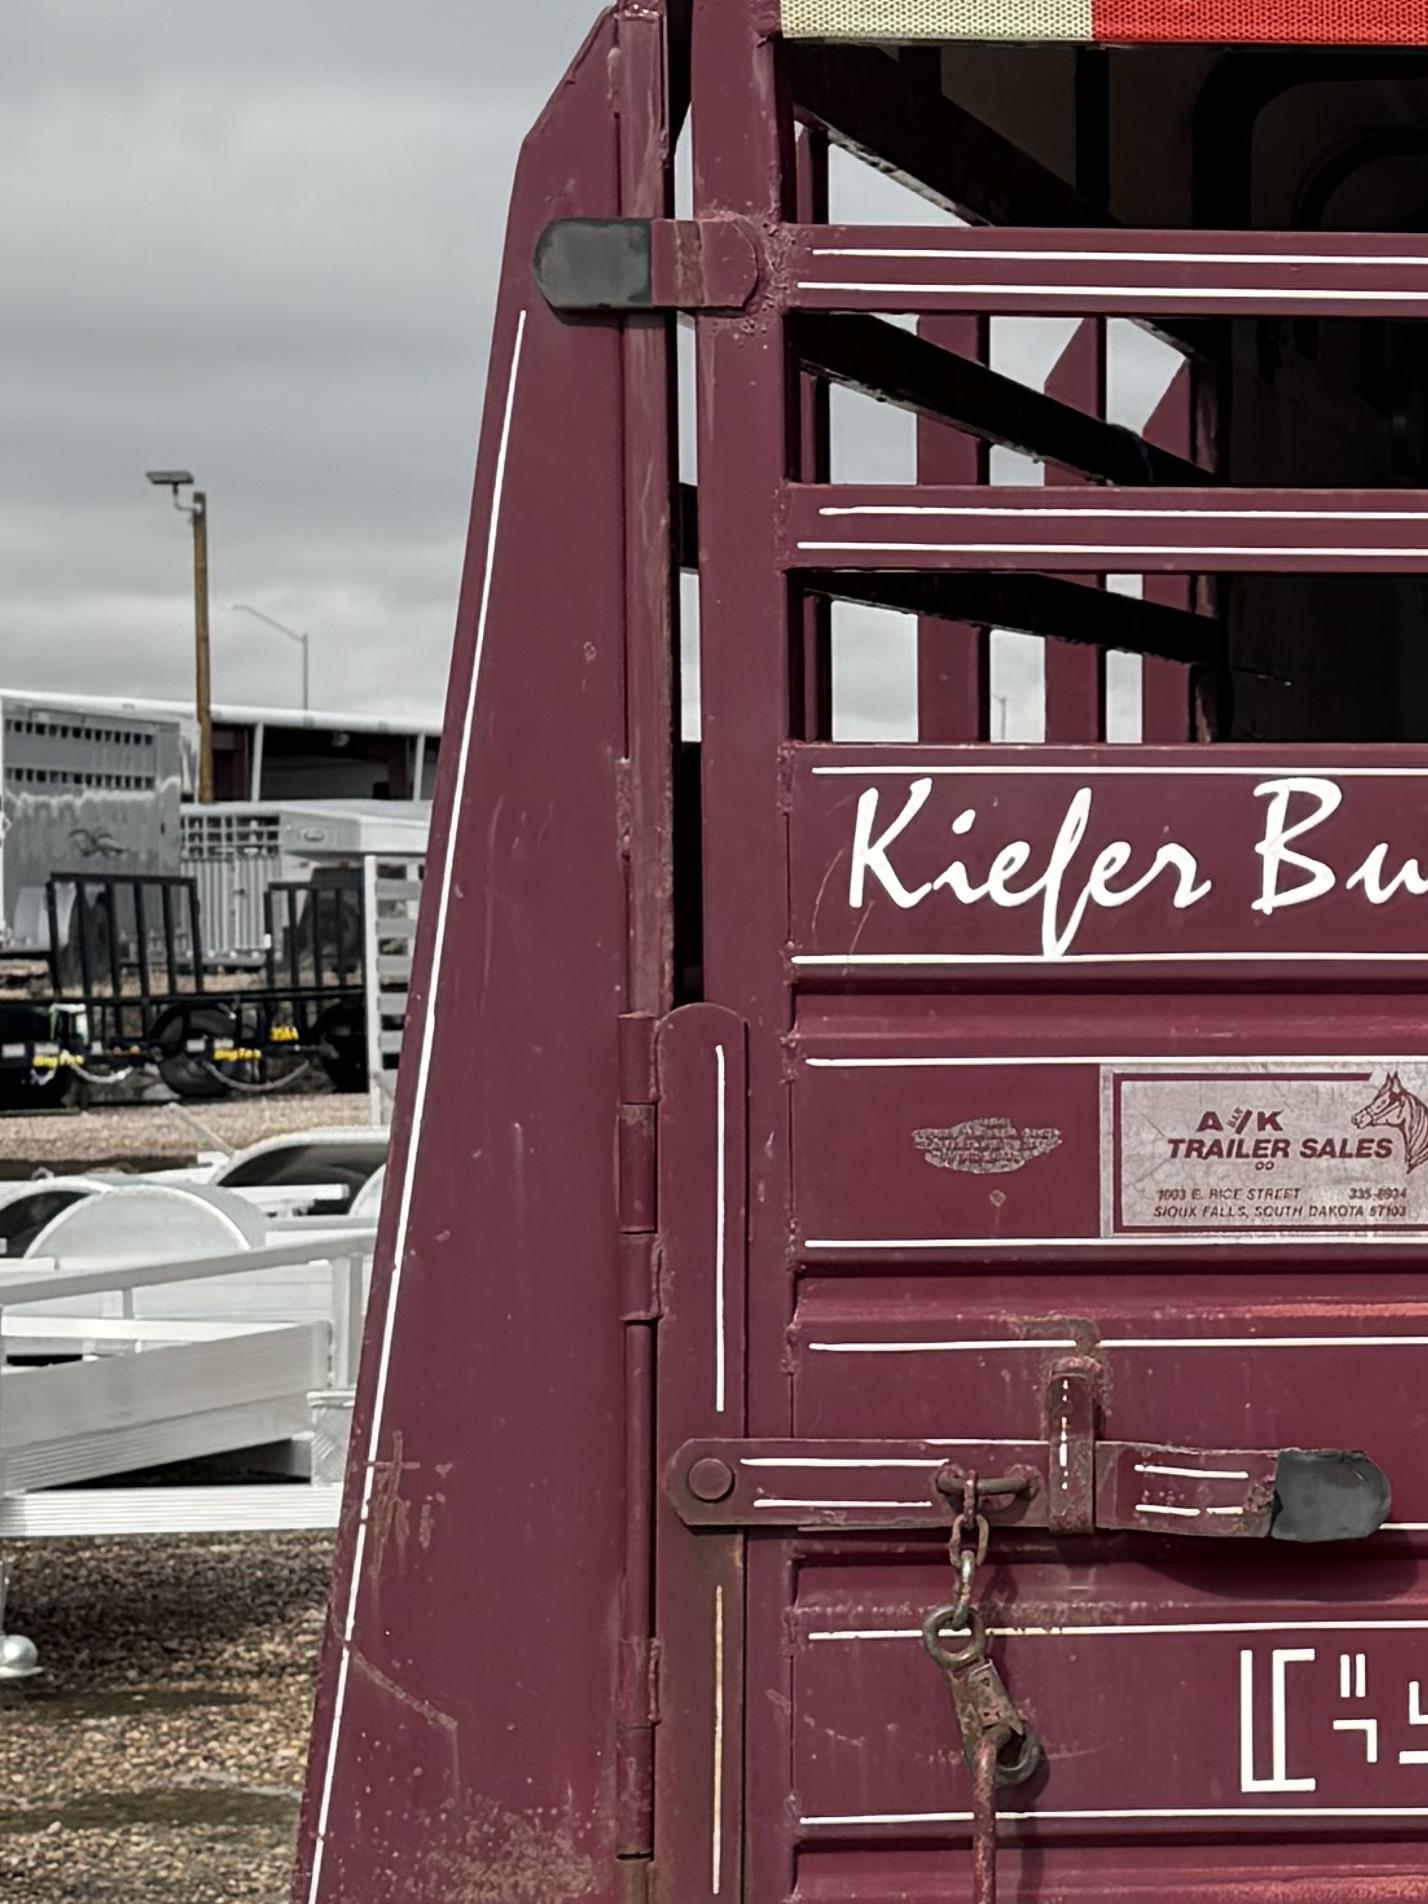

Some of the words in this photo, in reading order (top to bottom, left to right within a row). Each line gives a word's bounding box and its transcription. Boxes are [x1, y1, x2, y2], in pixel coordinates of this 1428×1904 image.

[848, 777, 1212, 956] Kiefer
[1167, 1138, 1290, 1161] TRAILER
[1299, 1138, 1393, 1160] SALES
[1208, 1187, 1243, 1201] RICE
[1246, 1187, 1302, 1201] STREET
[1152, 1205, 1197, 1219] SIOUX
[1254, 1205, 1304, 1218] SOUTH
[1308, 1204, 1365, 1218] DAKOTA
